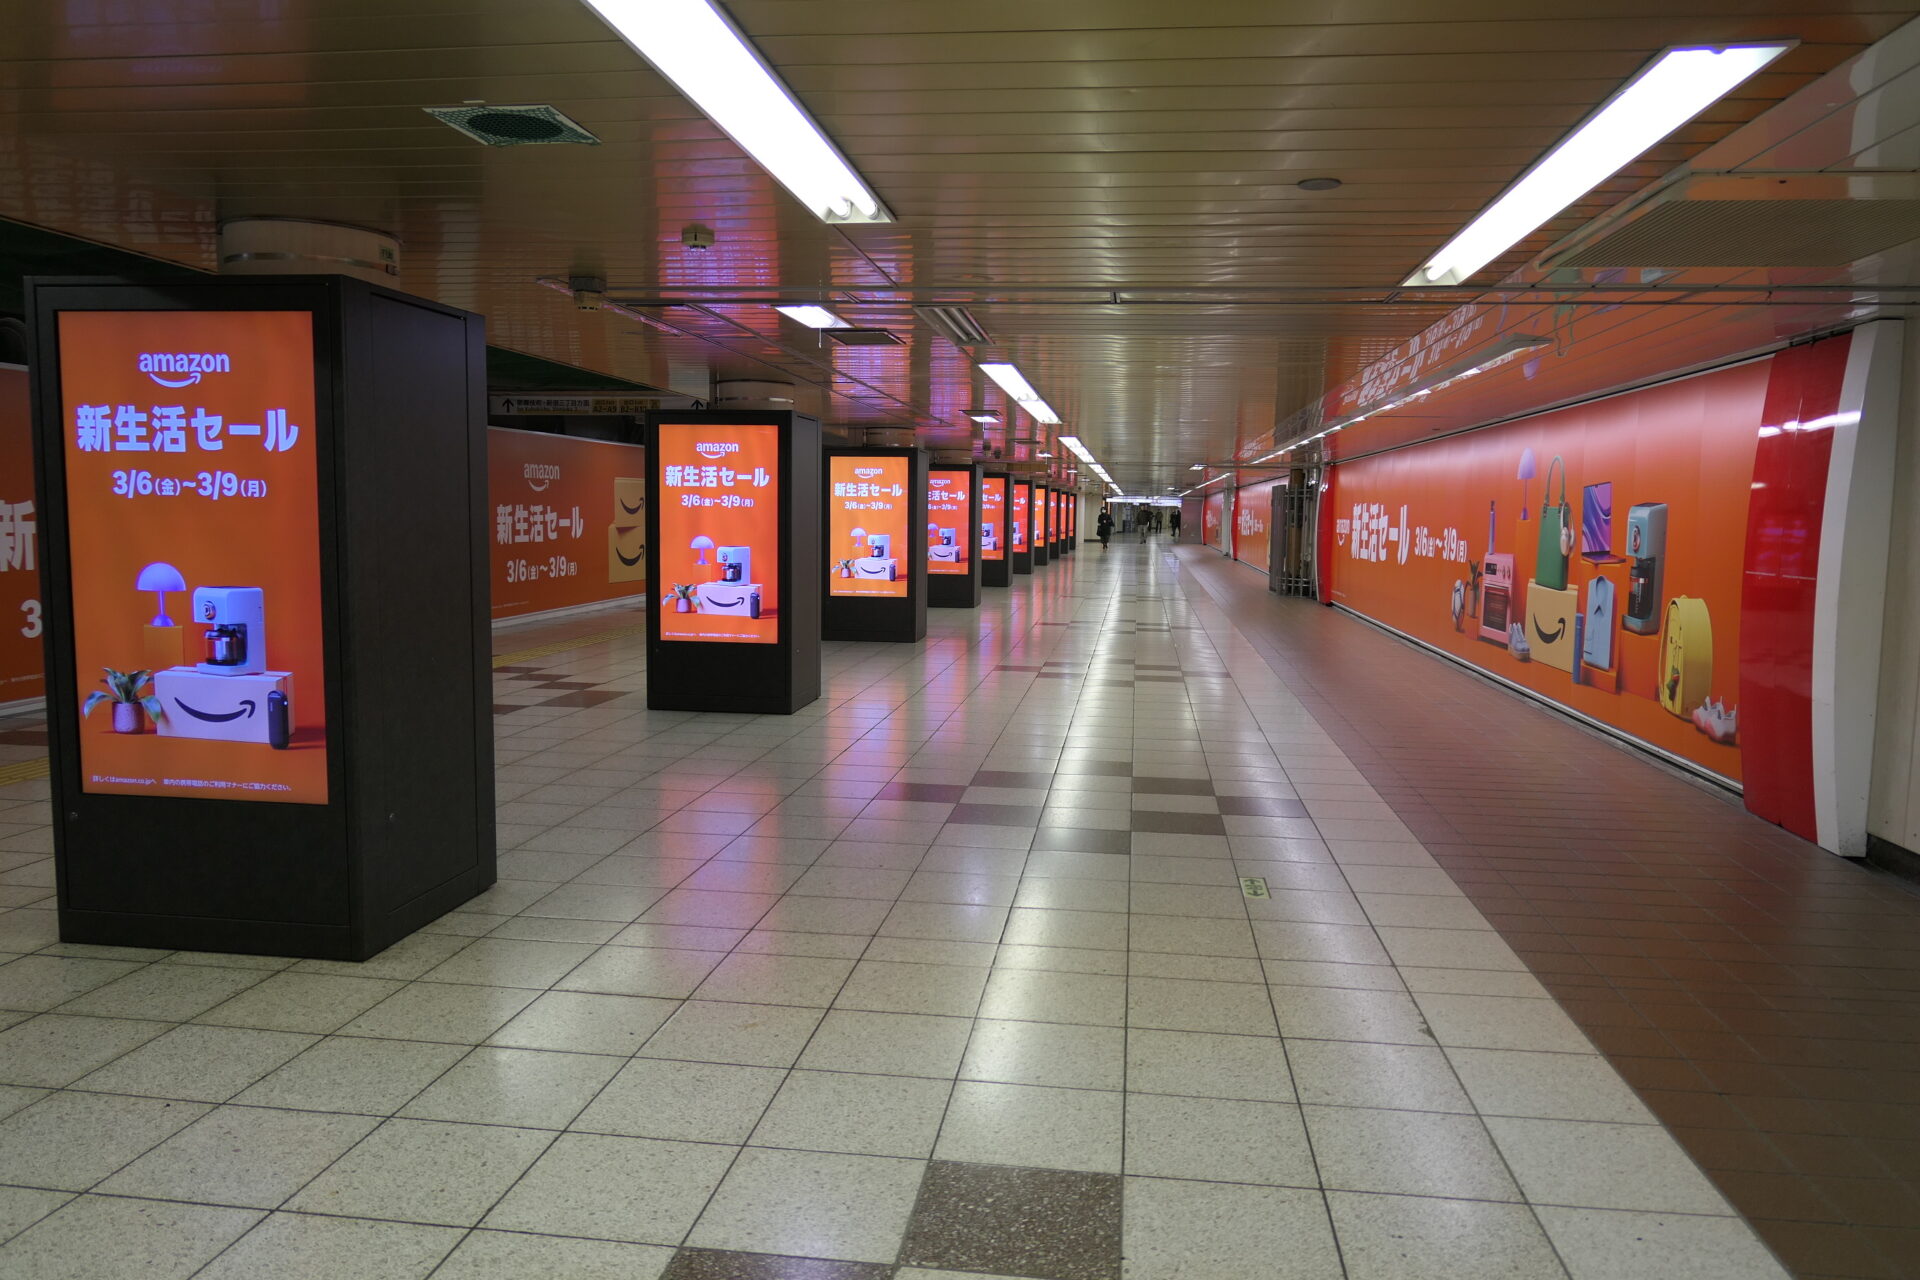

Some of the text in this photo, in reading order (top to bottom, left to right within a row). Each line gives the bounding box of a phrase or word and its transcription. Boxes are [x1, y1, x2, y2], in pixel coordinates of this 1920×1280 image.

[139, 353, 230, 373] amazon
[76, 405, 299, 453] 新生活セール
[696, 443, 739, 453] amazon
[524, 463, 560, 480] amazon
[665, 466, 771, 488] 新生活セール
[854, 467, 883, 475] amazon
[834, 482, 903, 497] 新生活セール
[496, 503, 584, 545] 新生活セール
[1351, 502, 1411, 566] 新生活セール
